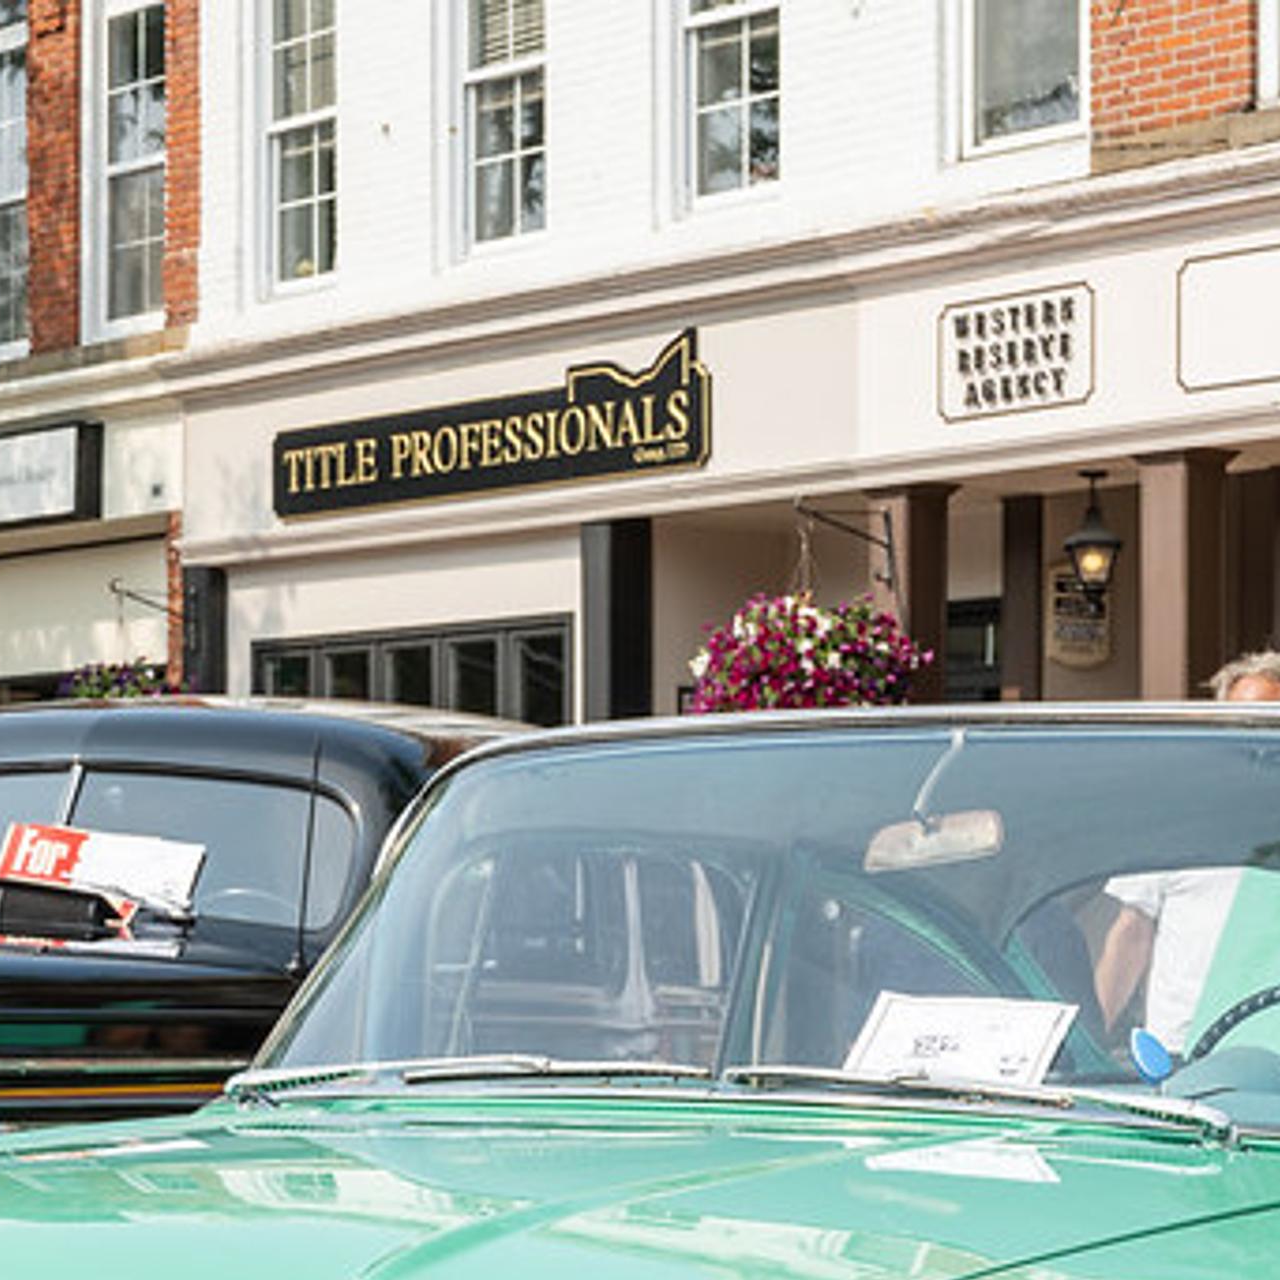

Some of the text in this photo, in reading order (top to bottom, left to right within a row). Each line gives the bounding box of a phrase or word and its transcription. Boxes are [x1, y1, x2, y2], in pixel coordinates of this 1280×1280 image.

[953, 296, 1075, 340] WESTERN
[957, 332, 1072, 376] RESERVE
[964, 366, 1067, 409] AGENCY
[283, 388, 690, 494] TITLE PROFESSIONALS
[13, 827, 69, 876] For
